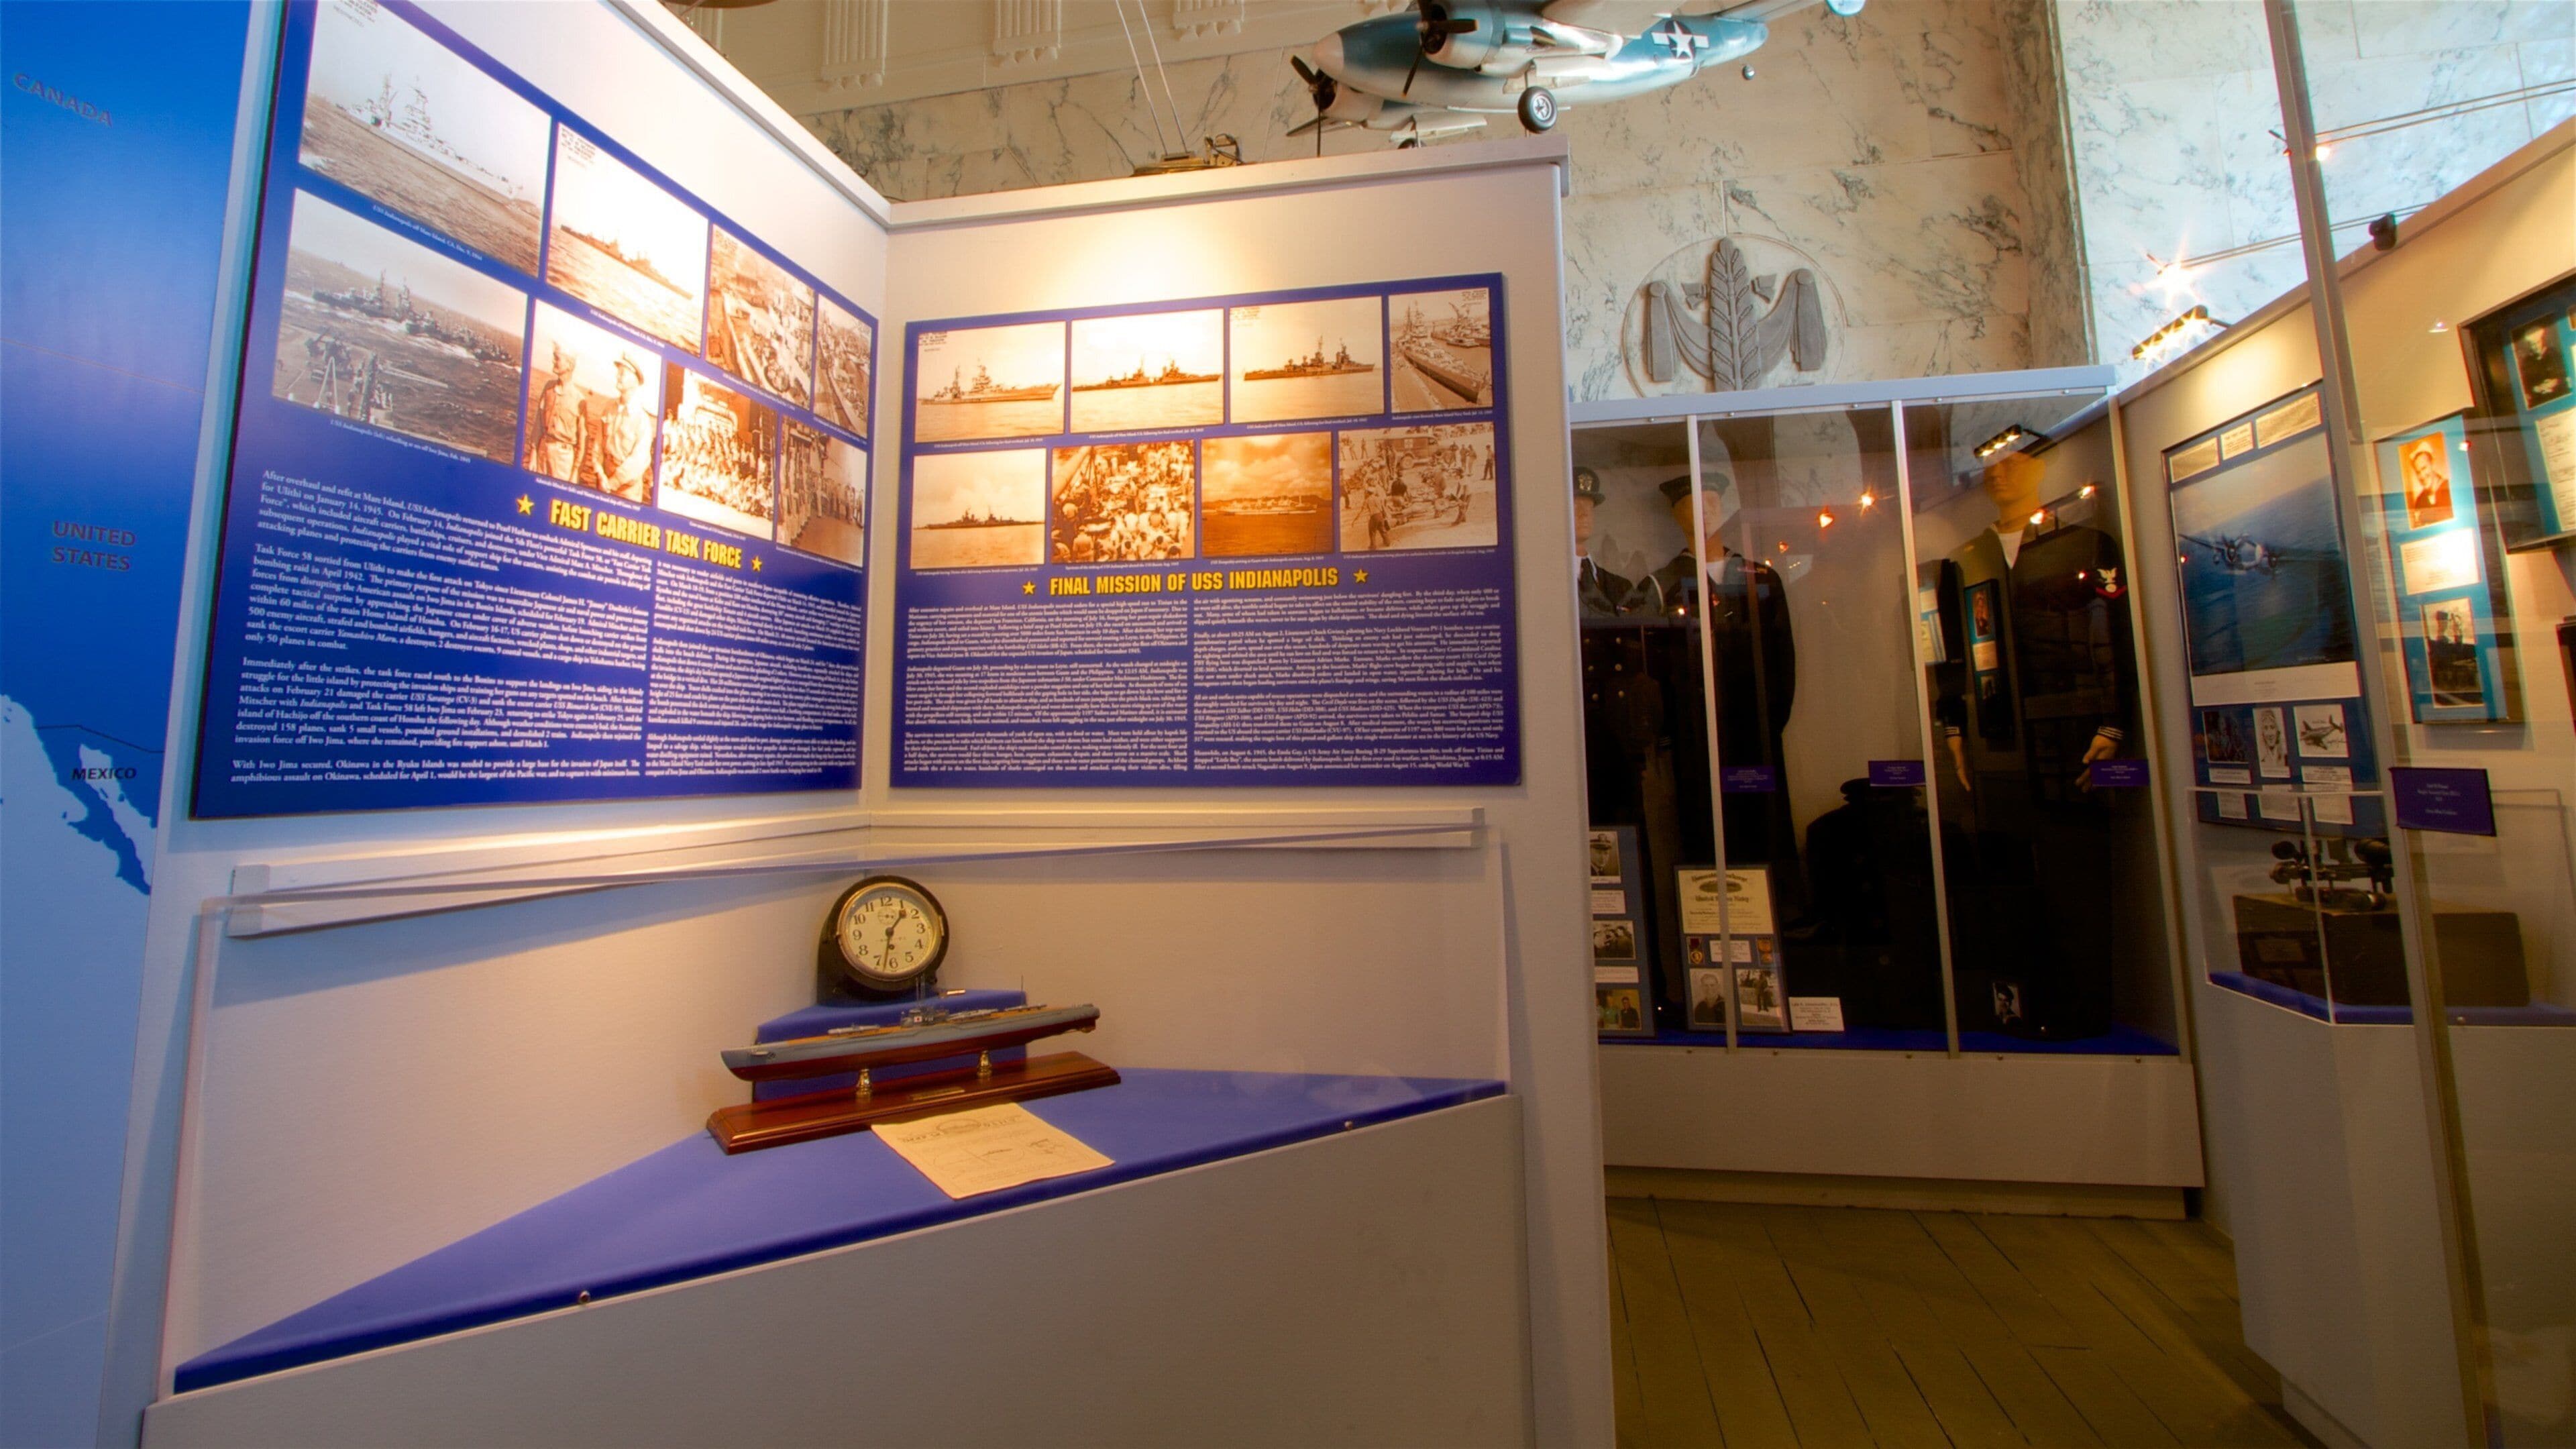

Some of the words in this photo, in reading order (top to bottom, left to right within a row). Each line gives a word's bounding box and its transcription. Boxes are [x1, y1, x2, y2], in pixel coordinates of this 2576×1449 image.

[13, 72, 113, 128] CANADA
[262, 469, 285, 482] After
[286, 476, 320, 490] overhaul
[321, 484, 335, 494] and
[337, 488, 352, 497] refit
[354, 491, 362, 499] at
[261, 481, 274, 492] for
[277, 484, 301, 498] Ulithi
[304, 492, 315, 501] on
[317, 493, 346, 510] January
[259, 507, 305, 523] subsequent
[292, 502, 316, 513] which
[319, 506, 351, 521] included
[53, 521, 136, 547] UNITED
[258, 519, 295, 536] attacking
[298, 527, 322, 539] planes
[324, 533, 339, 541] and
[550, 498, 592, 531] FAST
[596, 512, 661, 550] CARRIER
[665, 530, 699, 558] TASK
[703, 540, 742, 569] FORCE
[52, 546, 131, 572] STATES
[255, 543, 275, 555] Task
[277, 547, 299, 559] Force
[301, 551, 312, 561] 58
[314, 555, 341, 566] sortied
[343, 558, 361, 569] from
[254, 555, 290, 572] bombing
[293, 563, 309, 572] raid
[311, 565, 319, 574] in
[322, 566, 341, 579] April
[252, 568, 276, 580] forces
[278, 572, 299, 583] from
[301, 575, 341, 592] disrupting
[342, 582, 355, 591] the
[1050, 578, 1091, 596] FINAL
[1096, 576, 1161, 594] MISSION
[1167, 574, 1186, 591] OF
[1192, 572, 1223, 590] USS
[1229, 568, 1338, 589] INDIANAPOLIS
[251, 583, 289, 595] complete
[291, 586, 321, 598] tactical
[323, 593, 352, 604] surprise
[355, 595, 364, 607] by
[250, 594, 277, 605] within
[279, 597, 290, 607] 60
[292, 600, 314, 610] miles
[316, 602, 325, 611] of
[327, 603, 339, 613] the
[341, 606, 360, 615] main
[248, 605, 265, 616] 500
[266, 610, 293, 622] enemy
[294, 612, 325, 625] aircraft,
[327, 616, 352, 626] strafed
[247, 619, 266, 629] sank
[268, 620, 282, 630] the
[284, 624, 307, 633] escort
[309, 627, 334, 636] carrier
[246, 631, 264, 644] only
[266, 633, 278, 643] 50
[279, 635, 305, 646] planes
[307, 637, 315, 646] in
[243, 657, 295, 672] Immediately
[298, 661, 317, 671] after
[319, 663, 332, 672] the
[241, 669, 274, 682] struggle
[277, 672, 289, 681] for
[290, 673, 304, 682] the
[306, 674, 325, 684] little
[326, 675, 348, 685] island
[350, 677, 360, 688] by
[240, 682, 269, 692] attacks
[286, 685, 321, 698] February
[323, 687, 333, 696] 21
[239, 694, 277, 705] Mitscher
[278, 696, 298, 706] with
[299, 698, 347, 710] Indianapolis
[237, 707, 263, 717] island
[265, 708, 276, 717] of
[276, 708, 308, 721] Hachijo
[309, 710, 322, 719] off
[322, 710, 335, 720] the
[236, 720, 276, 733] destroyed
[280, 722, 295, 731] 158
[329, 724, 347, 732] sank
[349, 724, 354, 733] 5
[235, 733, 270, 743] invasion
[272, 734, 292, 743] force
[294, 735, 308, 743] off
[309, 735, 323, 743] Iwo
[231, 758, 256, 768] With
[259, 759, 275, 768] Iwo
[278, 759, 297, 771] Jima
[72, 767, 137, 780] MEXICO
[230, 771, 281, 784] amphibious
[283, 771, 311, 780] assault
[865, 902, 875, 913] 11
[879, 896, 892, 907] 12
[899, 900, 904, 909] 1
[853, 914, 865, 925] 10
[910, 909, 920, 920] 2
[853, 930, 862, 940] 9
[916, 923, 926, 934] 3
[859, 945, 868, 956] 8
[915, 940, 924, 950] 4
[873, 955, 882, 966] 7
[889, 958, 898, 969] 6
[905, 952, 914, 963] 5
